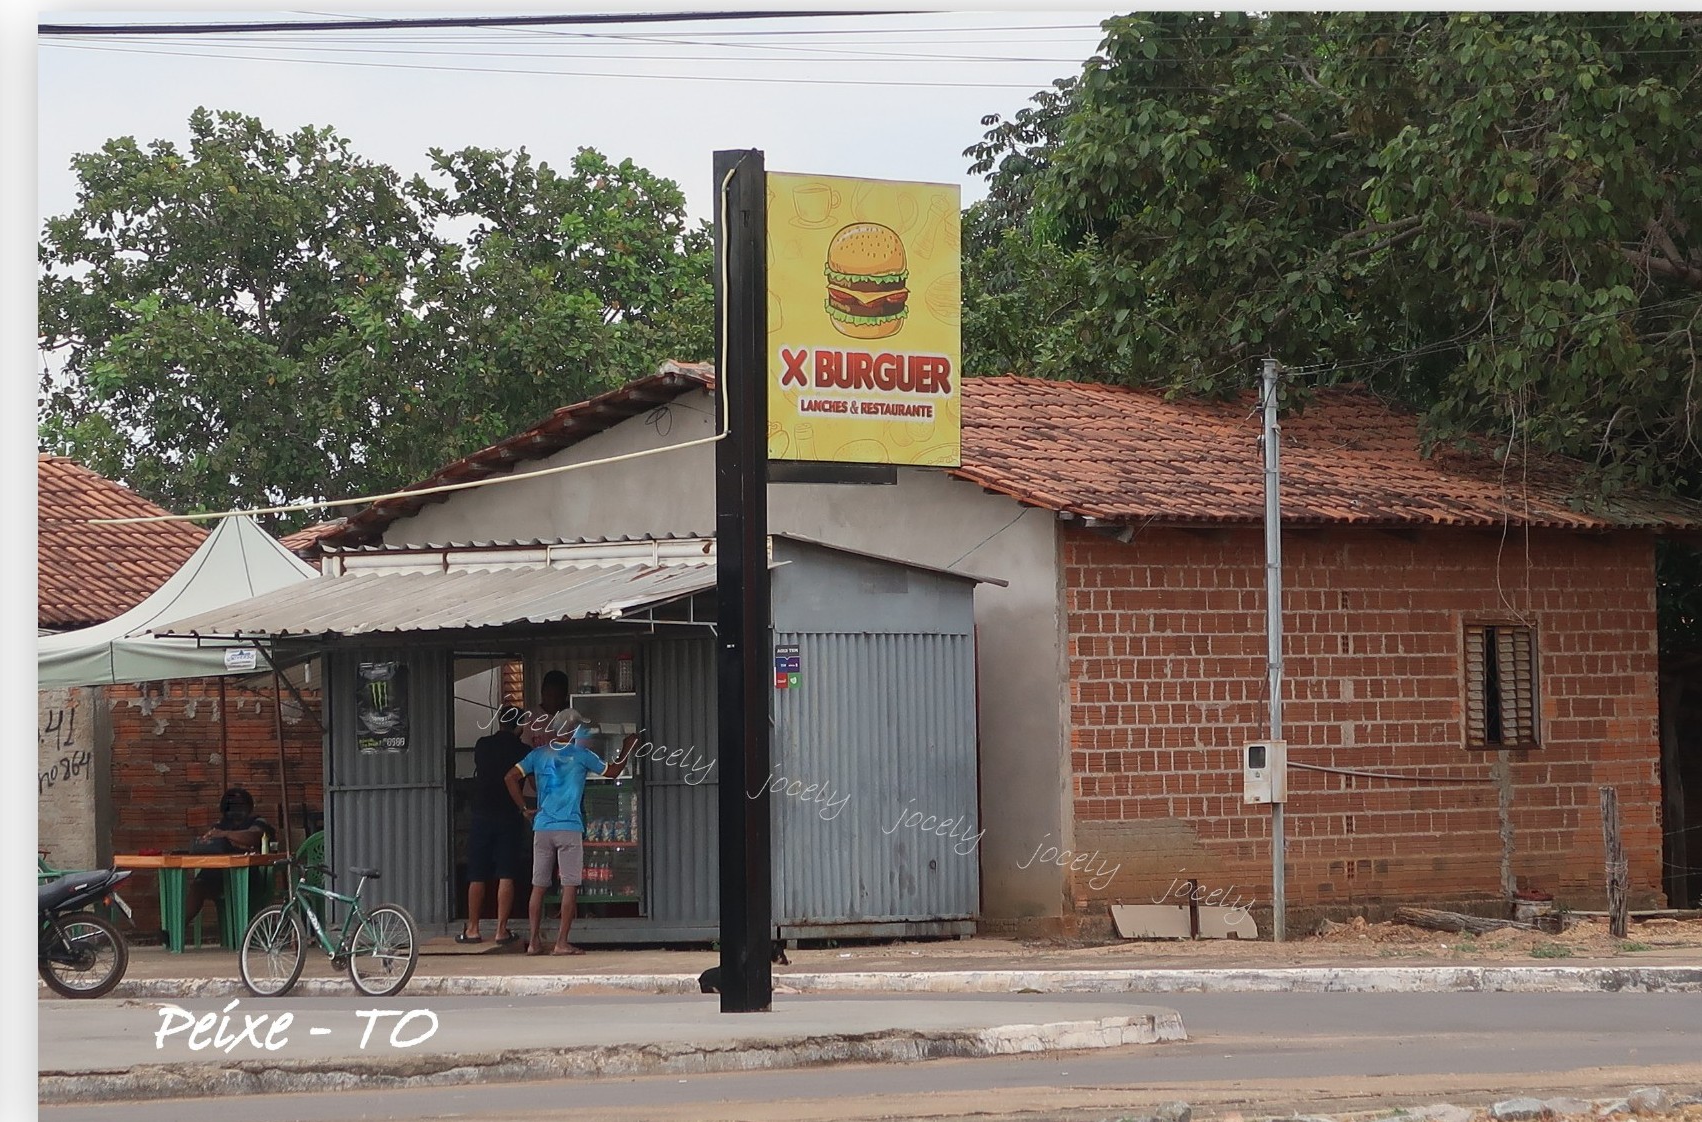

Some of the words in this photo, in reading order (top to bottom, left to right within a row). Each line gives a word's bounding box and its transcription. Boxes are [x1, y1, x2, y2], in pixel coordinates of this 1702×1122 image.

[781, 348, 808, 388] X
[815, 350, 952, 395] BURGUER
[801, 399, 847, 413] LANCHES
[849, 400, 859, 415] &
[860, 402, 933, 418] RESTAURANTE
